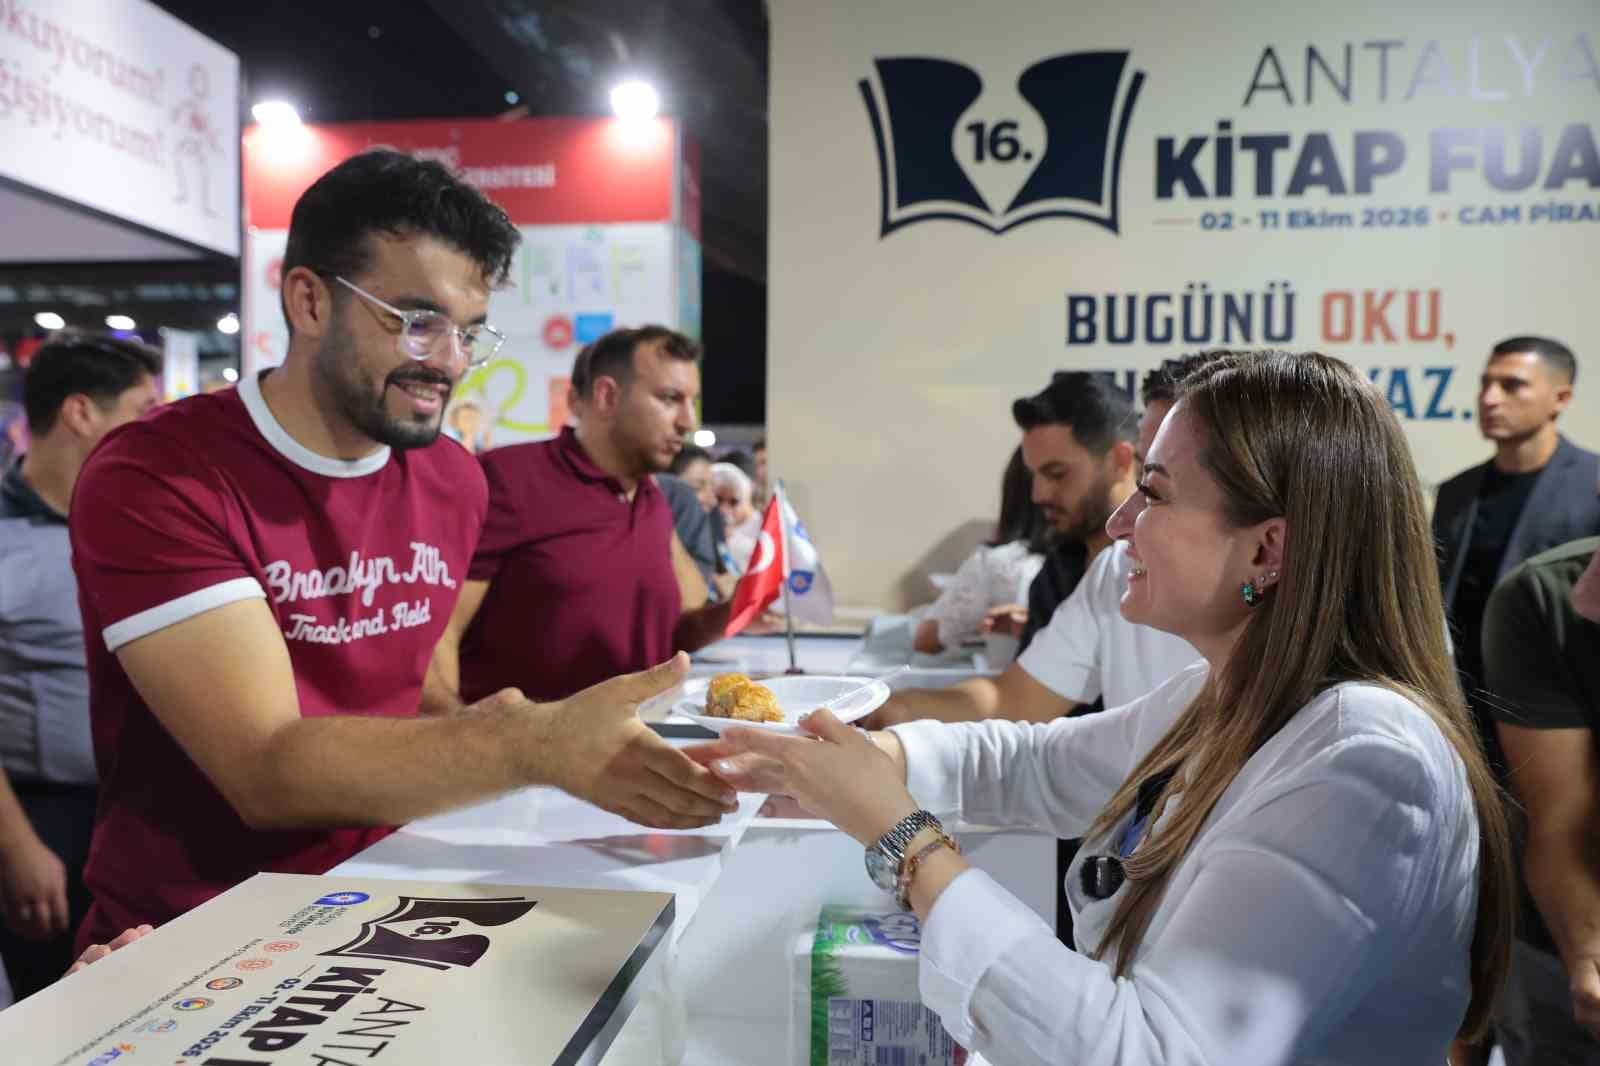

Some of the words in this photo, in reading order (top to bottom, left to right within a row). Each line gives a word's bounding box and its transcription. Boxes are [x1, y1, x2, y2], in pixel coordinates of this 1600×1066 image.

[0, 0, 163, 106] kuyorum!
[967, 121, 1033, 163] 16.
[1155, 119, 1407, 199] KİTAP
[1200, 210, 1233, 230] 02
[1259, 210, 1280, 229] 11
[1287, 209, 1353, 229] Ekim
[1458, 205, 1521, 225] CAM
[1530, 199, 1600, 224] PİRA
[1066, 283, 1296, 346] BUGÜNÜ
[1321, 289, 1455, 350] OKU,
[285, 613, 352, 644] Track
[390, 597, 431, 631] Field
[409, 920, 460, 938] 16.
[275, 978, 302, 990] 02
[220, 1005, 265, 1029] Ekim
[240, 966, 387, 1052] KİTAP
